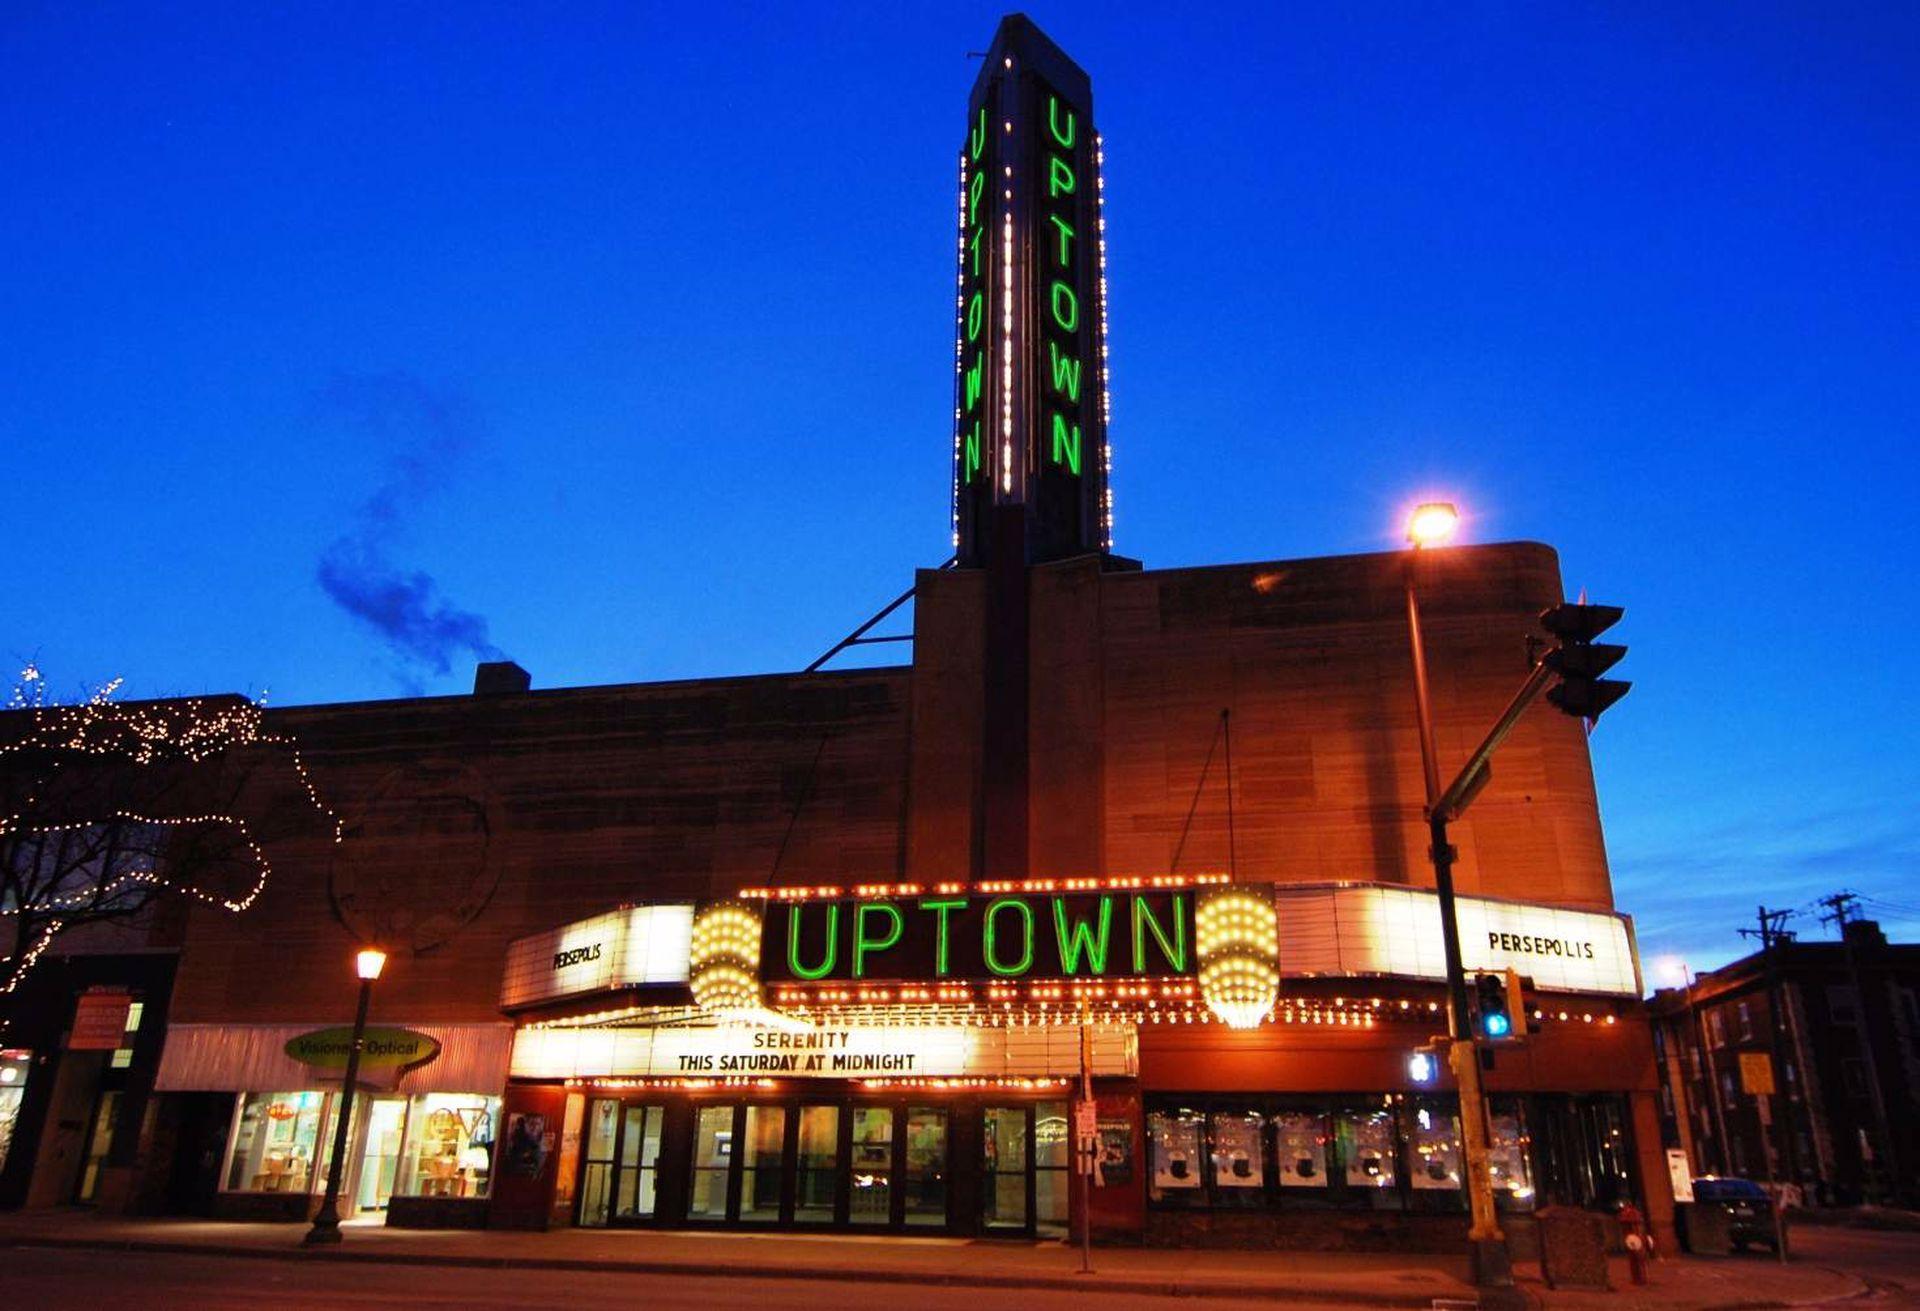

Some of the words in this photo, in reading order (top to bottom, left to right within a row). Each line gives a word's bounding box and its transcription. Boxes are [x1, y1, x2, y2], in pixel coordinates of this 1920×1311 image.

[966, 108, 987, 485] UPTOWN
[1049, 97, 1081, 475] UPTOWN
[787, 894, 1188, 979] UPTOWN
[1488, 931, 1594, 960] PERSEPOLIS
[553, 943, 602, 970] PERSEPOLIS
[366, 1040, 419, 1056] Optical
[754, 1032, 849, 1048] SERENITY
[679, 1055, 713, 1070] THIS
[719, 1054, 800, 1071] SATURDAY
[804, 1054, 825, 1070] AT
[832, 1053, 915, 1070] MIDNIGHT
